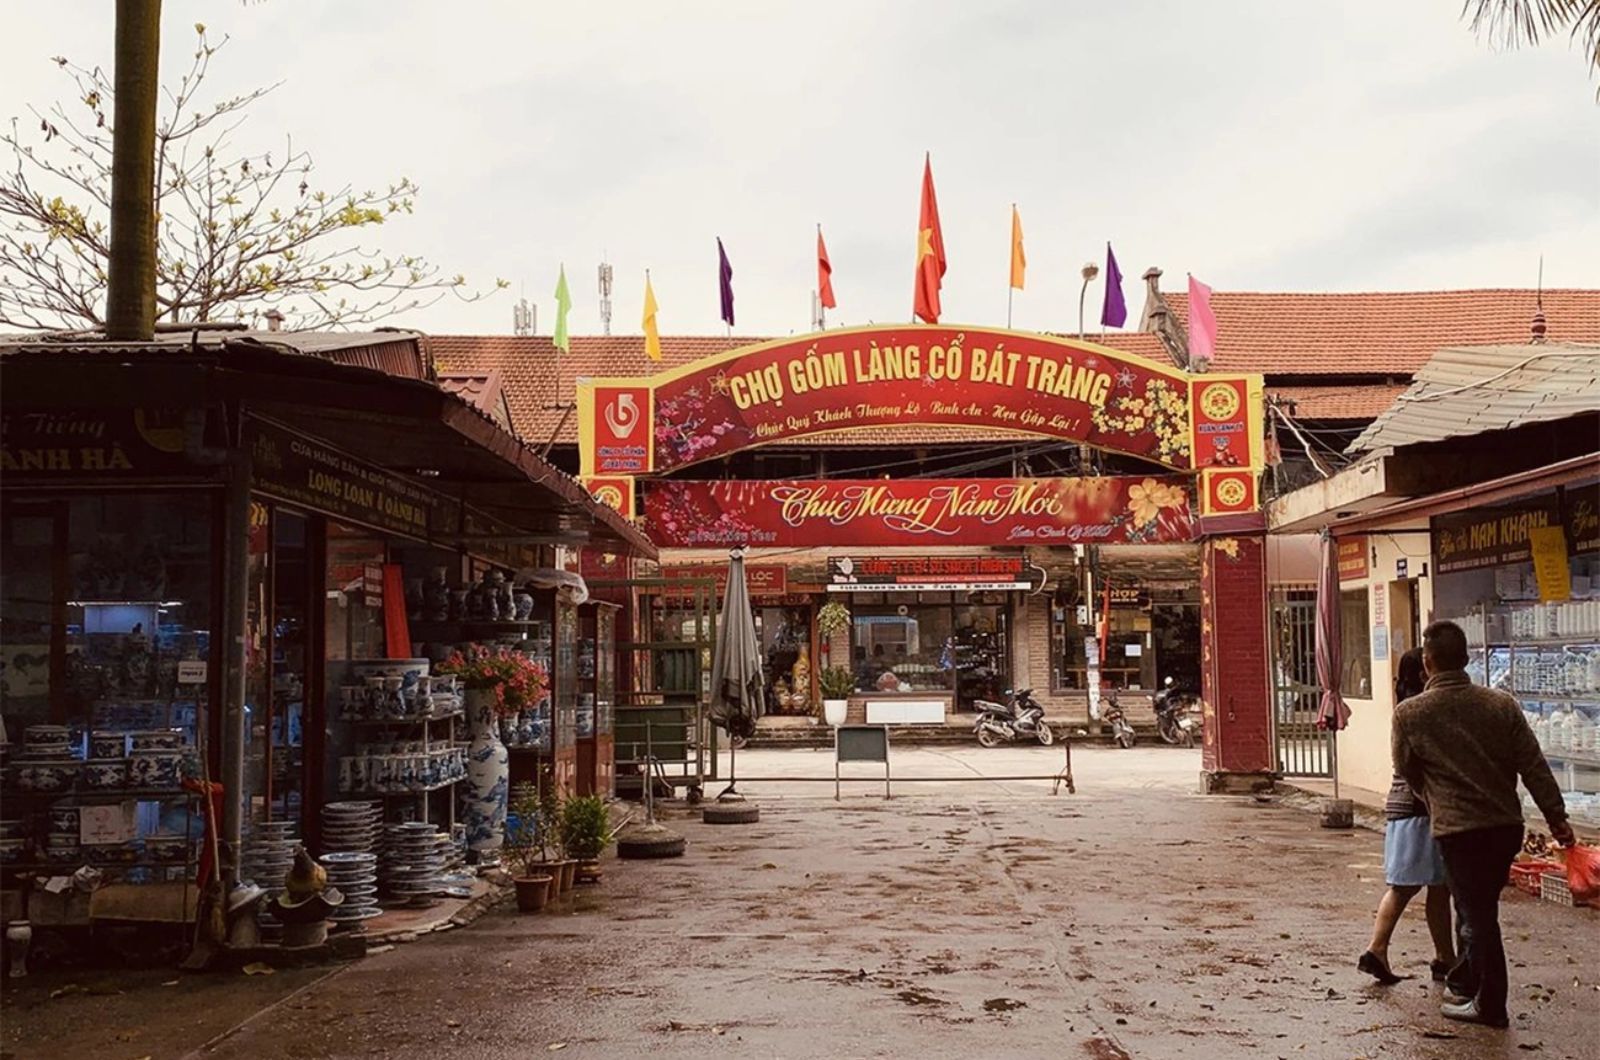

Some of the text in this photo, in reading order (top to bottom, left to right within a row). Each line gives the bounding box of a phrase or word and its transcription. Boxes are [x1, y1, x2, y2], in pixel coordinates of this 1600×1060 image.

[730, 332, 1112, 410] CHỢ GỐM LÀNG CỔ BÁT TRÀNG
[81, 441, 134, 471] HÀ
[308, 468, 342, 498] LONG
[344, 482, 374, 510] LOAN
[771, 484, 1063, 534] Chúc Mừng Năm Mới
[1471, 520, 1498, 552] NAM
